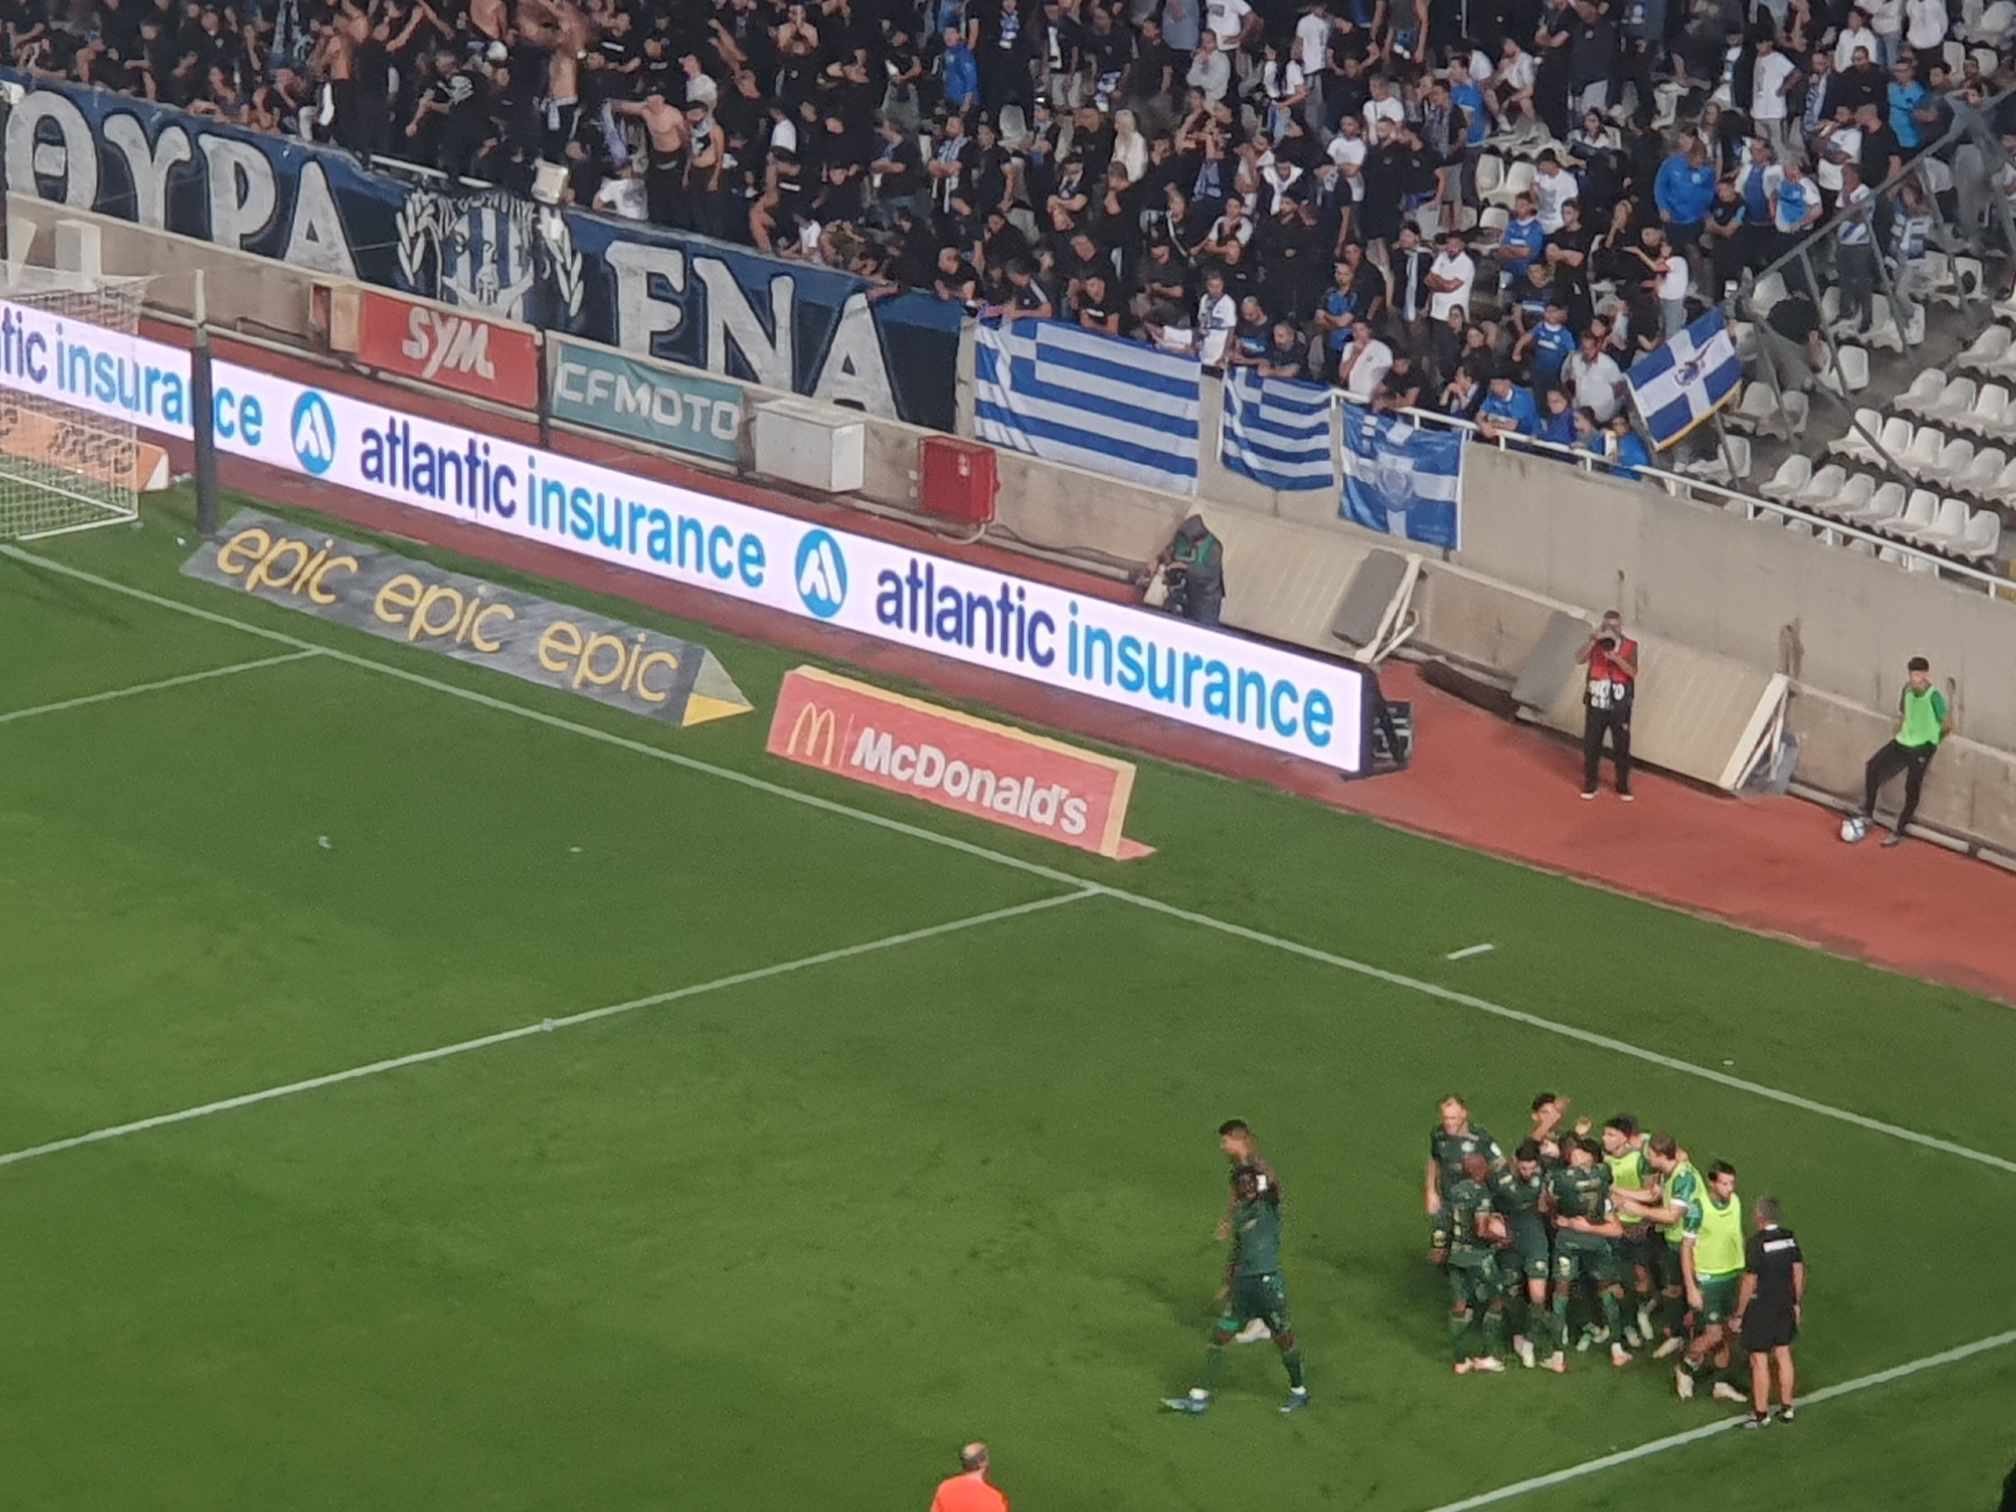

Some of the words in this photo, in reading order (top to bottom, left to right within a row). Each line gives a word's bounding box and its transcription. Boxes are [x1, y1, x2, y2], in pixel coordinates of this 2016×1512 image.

[55, 322, 265, 447] insurace
[401, 307, 496, 381] SYM
[554, 362, 742, 441] CFMOTO
[361, 417, 517, 518] atlantic
[527, 456, 767, 590] insurance
[215, 527, 359, 605] epic
[373, 573, 516, 653] epic
[537, 621, 679, 702] epic
[875, 558, 1056, 669] atlantic
[1067, 601, 1336, 749] insurance
[850, 726, 1088, 836] McDonald's
